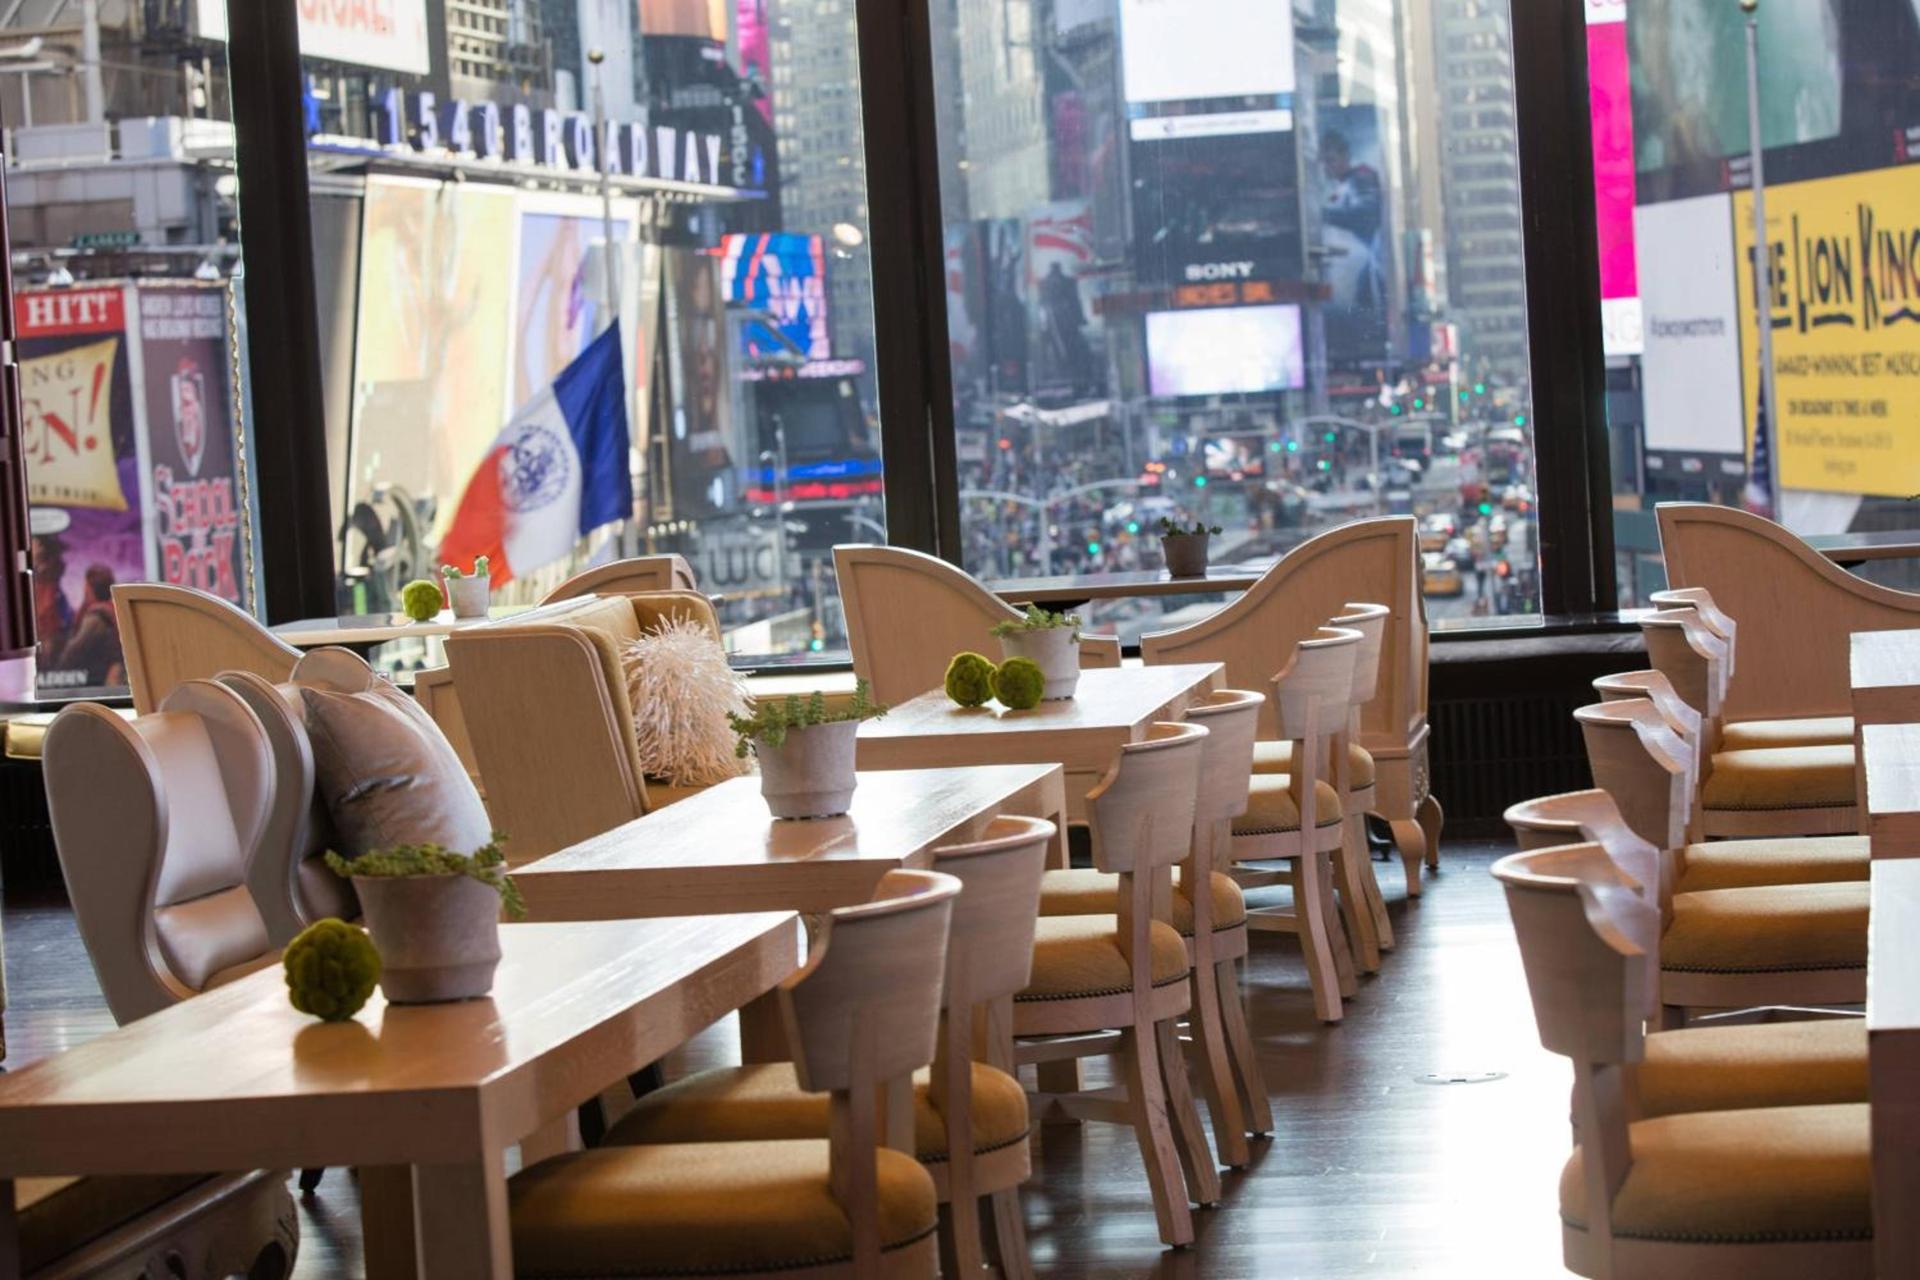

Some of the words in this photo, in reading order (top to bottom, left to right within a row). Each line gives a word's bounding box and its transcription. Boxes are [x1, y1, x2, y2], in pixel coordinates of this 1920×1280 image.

[377, 86, 500, 158] 1540
[512, 103, 722, 186] BROADWAY
[1185, 260, 1255, 281] SONY
[26, 292, 108, 328] HIT!
[154, 464, 238, 536] SCHOOL
